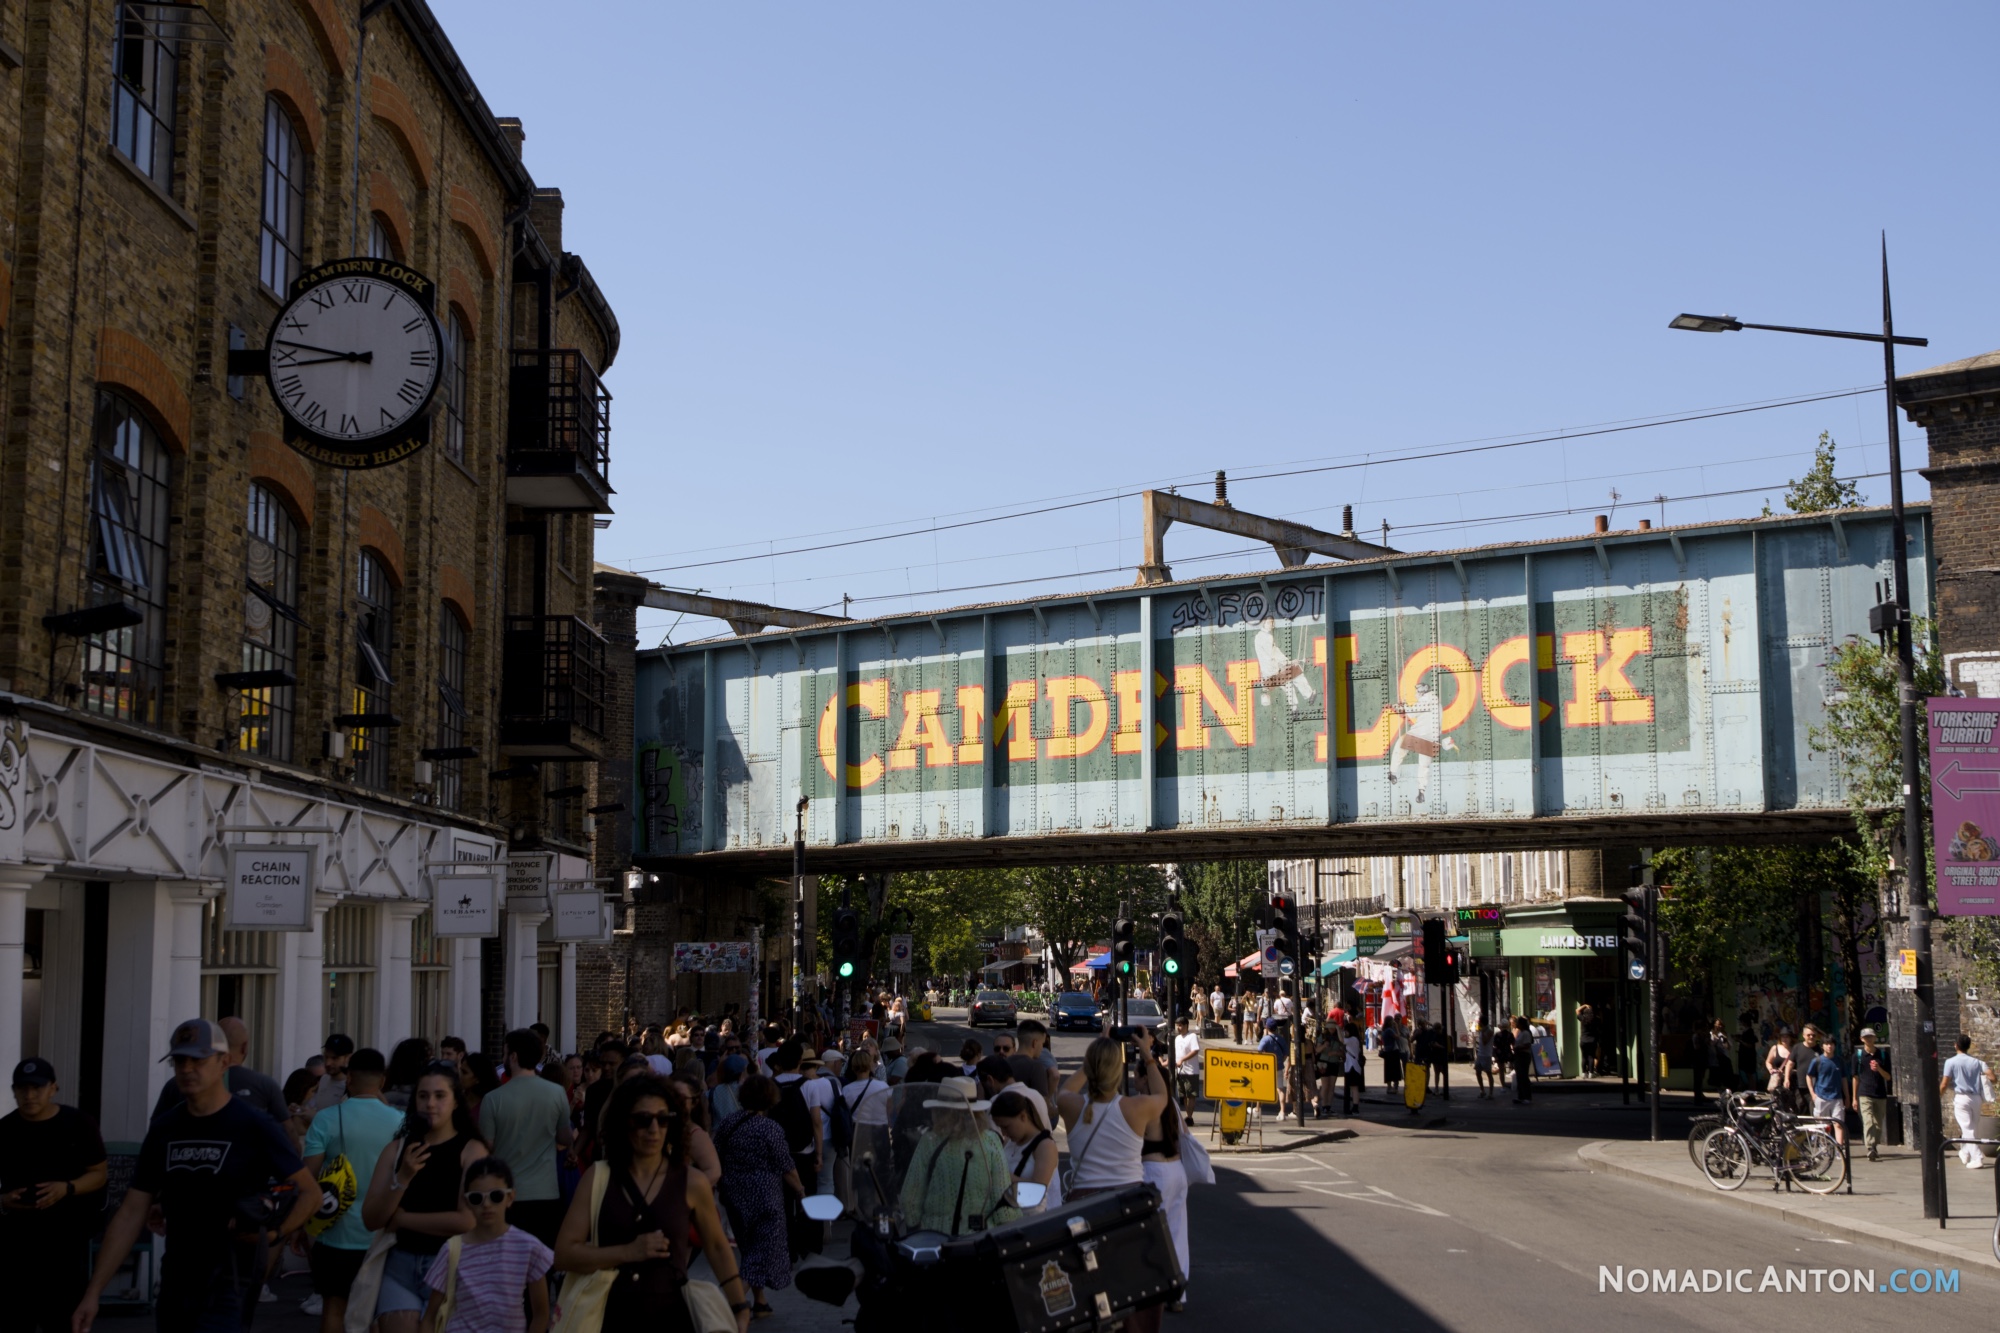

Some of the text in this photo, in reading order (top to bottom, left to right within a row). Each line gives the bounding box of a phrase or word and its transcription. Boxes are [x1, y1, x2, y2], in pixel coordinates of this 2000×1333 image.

[298, 261, 428, 294] CAMDEN LOCK
[291, 436, 421, 466] MARKET HALL
[817, 626, 1655, 788] CAMDEN LOCK
[1933, 711, 1999, 728] YORKSHIRE
[1941, 727, 1992, 744] BURRITO
[251, 861, 291, 872] CHAIN
[1944, 866, 2000, 876] ORIGINAL BRITIS
[241, 874, 300, 885] REACTION
[506, 876, 542, 884] ORKSHOPS
[1951, 876, 1998, 886] STREET FOOD
[1458, 908, 1499, 920] TATTOO
[1575, 935, 1619, 948] STRE
[1210, 1056, 1270, 1072] Diversion
[1043, 1276, 1068, 1293] KINGS
